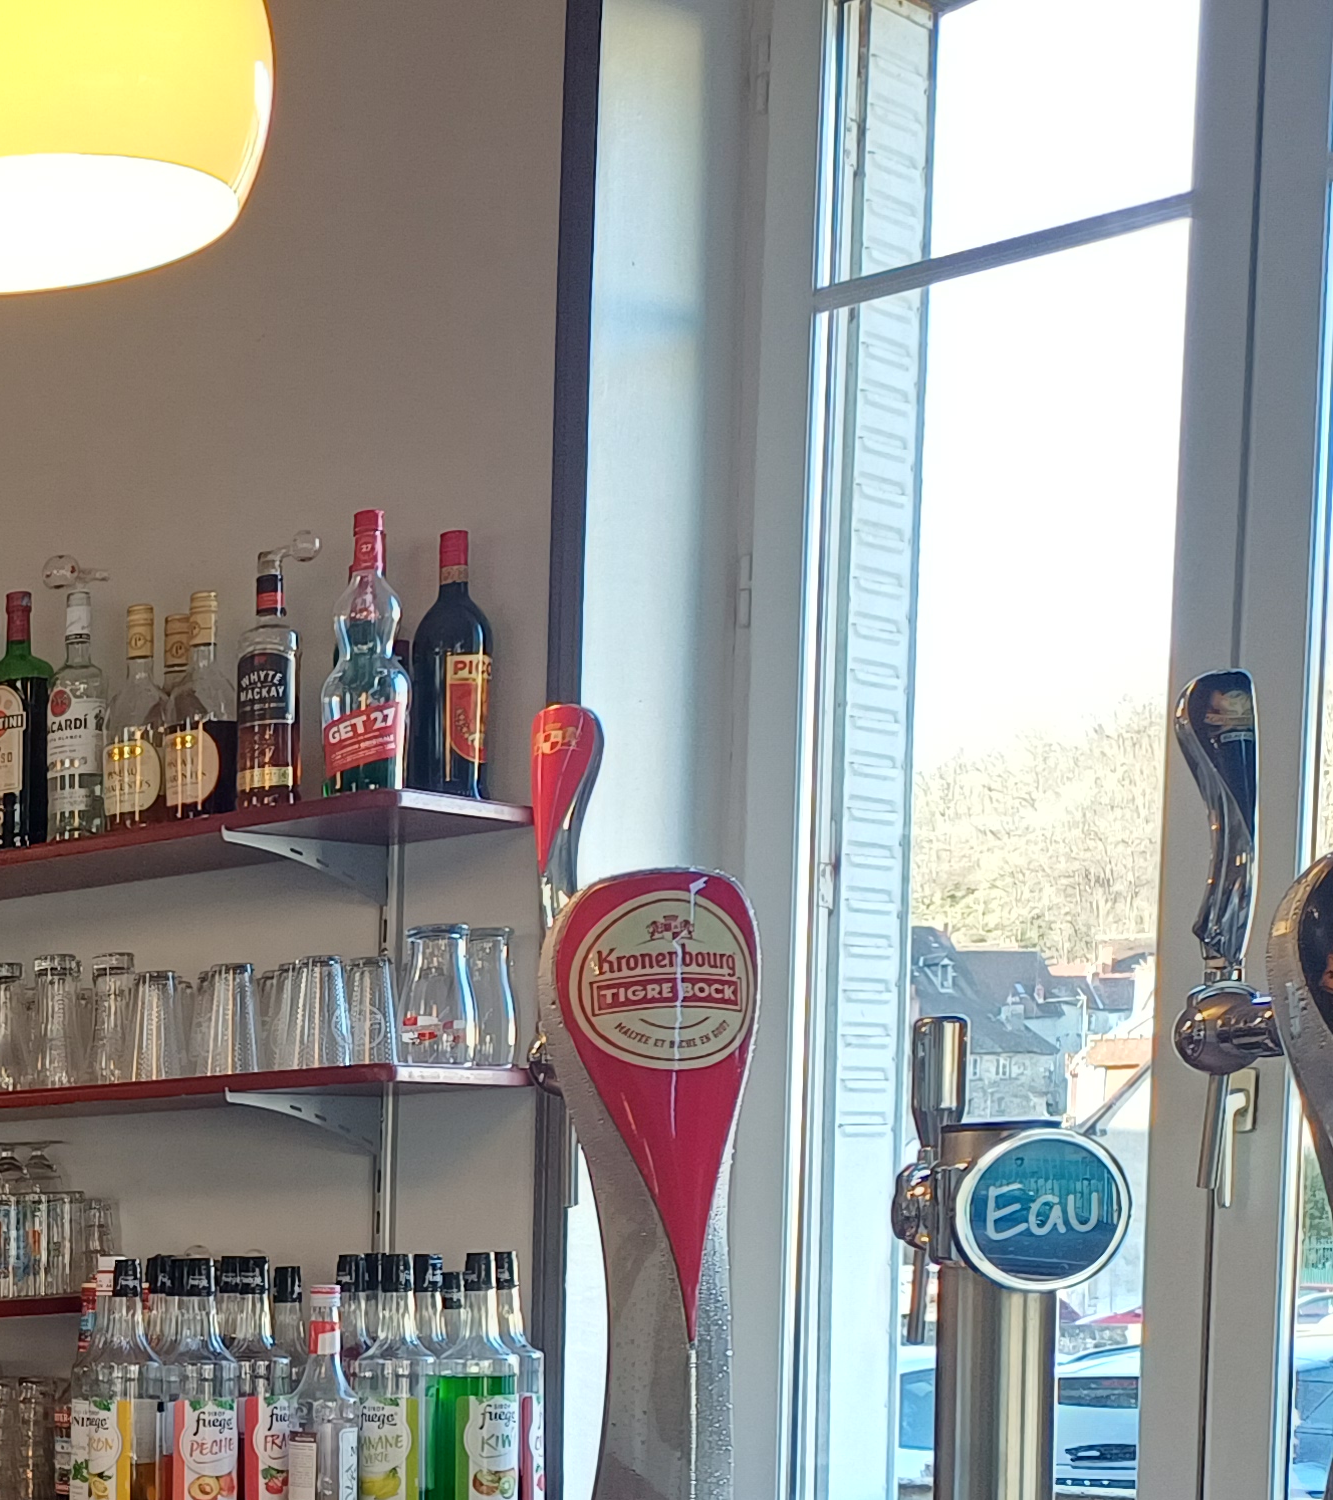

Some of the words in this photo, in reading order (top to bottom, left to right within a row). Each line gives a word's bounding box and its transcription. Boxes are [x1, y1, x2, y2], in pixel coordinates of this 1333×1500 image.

[240, 670, 283, 688] WHYTE
[47, 713, 89, 735] CARDÍ
[328, 714, 367, 744] GET
[370, 706, 396, 731] 27
[596, 943, 737, 978] Kronenbourg
[599, 982, 674, 1004] TIGRE
[682, 982, 736, 1001] BOCK
[653, 1038, 667, 1048] ET
[669, 1037, 698, 1049] RCHE
[985, 1182, 1100, 1241] Eau
[189, 1437, 235, 1459] PÊCHE
[361, 1433, 405, 1451] ANANE
[480, 1433, 513, 1454] KIW
